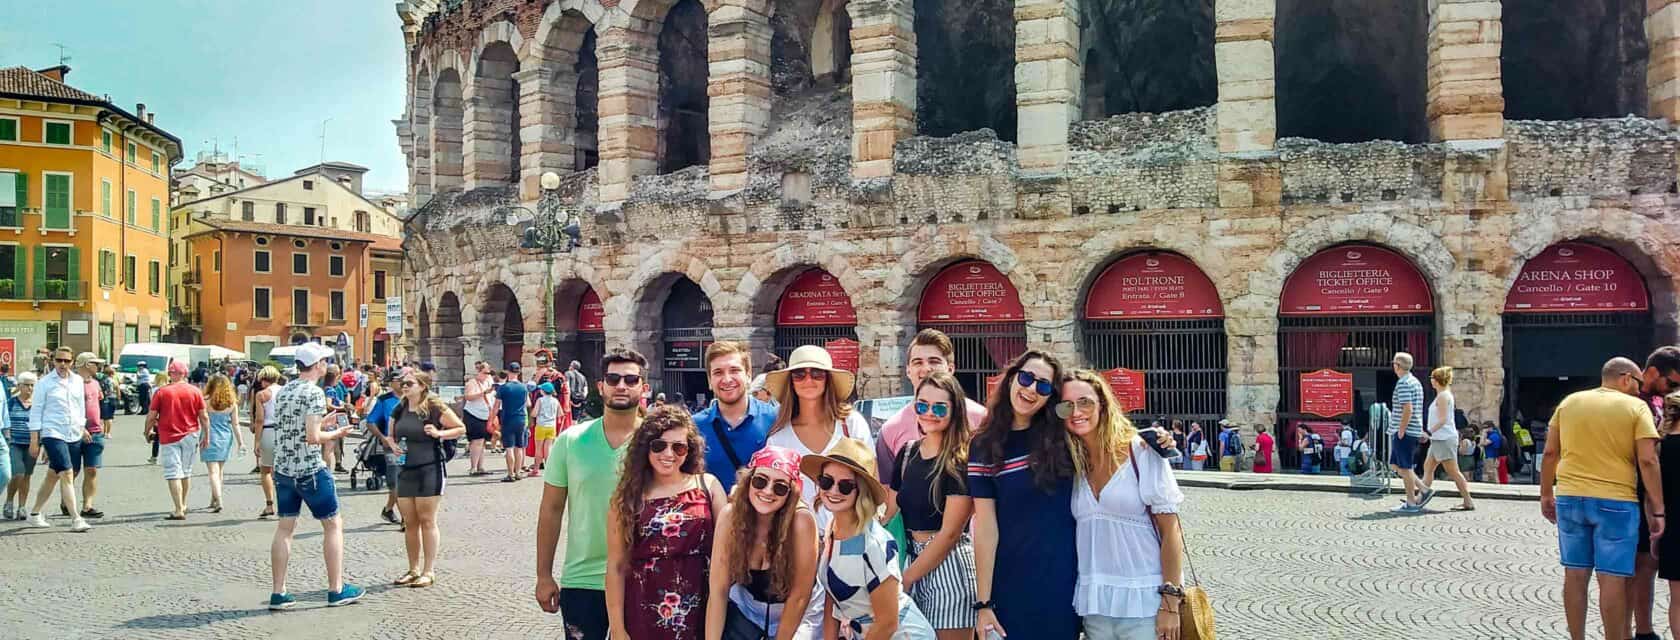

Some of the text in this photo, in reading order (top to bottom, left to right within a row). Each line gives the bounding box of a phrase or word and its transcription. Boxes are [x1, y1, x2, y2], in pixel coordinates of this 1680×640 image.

[1319, 270, 1390, 278] BIGLIETTERIA
[1520, 270, 1615, 281] ARENA SHOP
[1122, 276, 1185, 286] POLTRONE
[1317, 278, 1354, 286] TICKET
[948, 282, 1004, 290] BIGLIETTERIA
[1518, 284, 1563, 292] Cancello
[1604, 283, 1617, 291] 10
